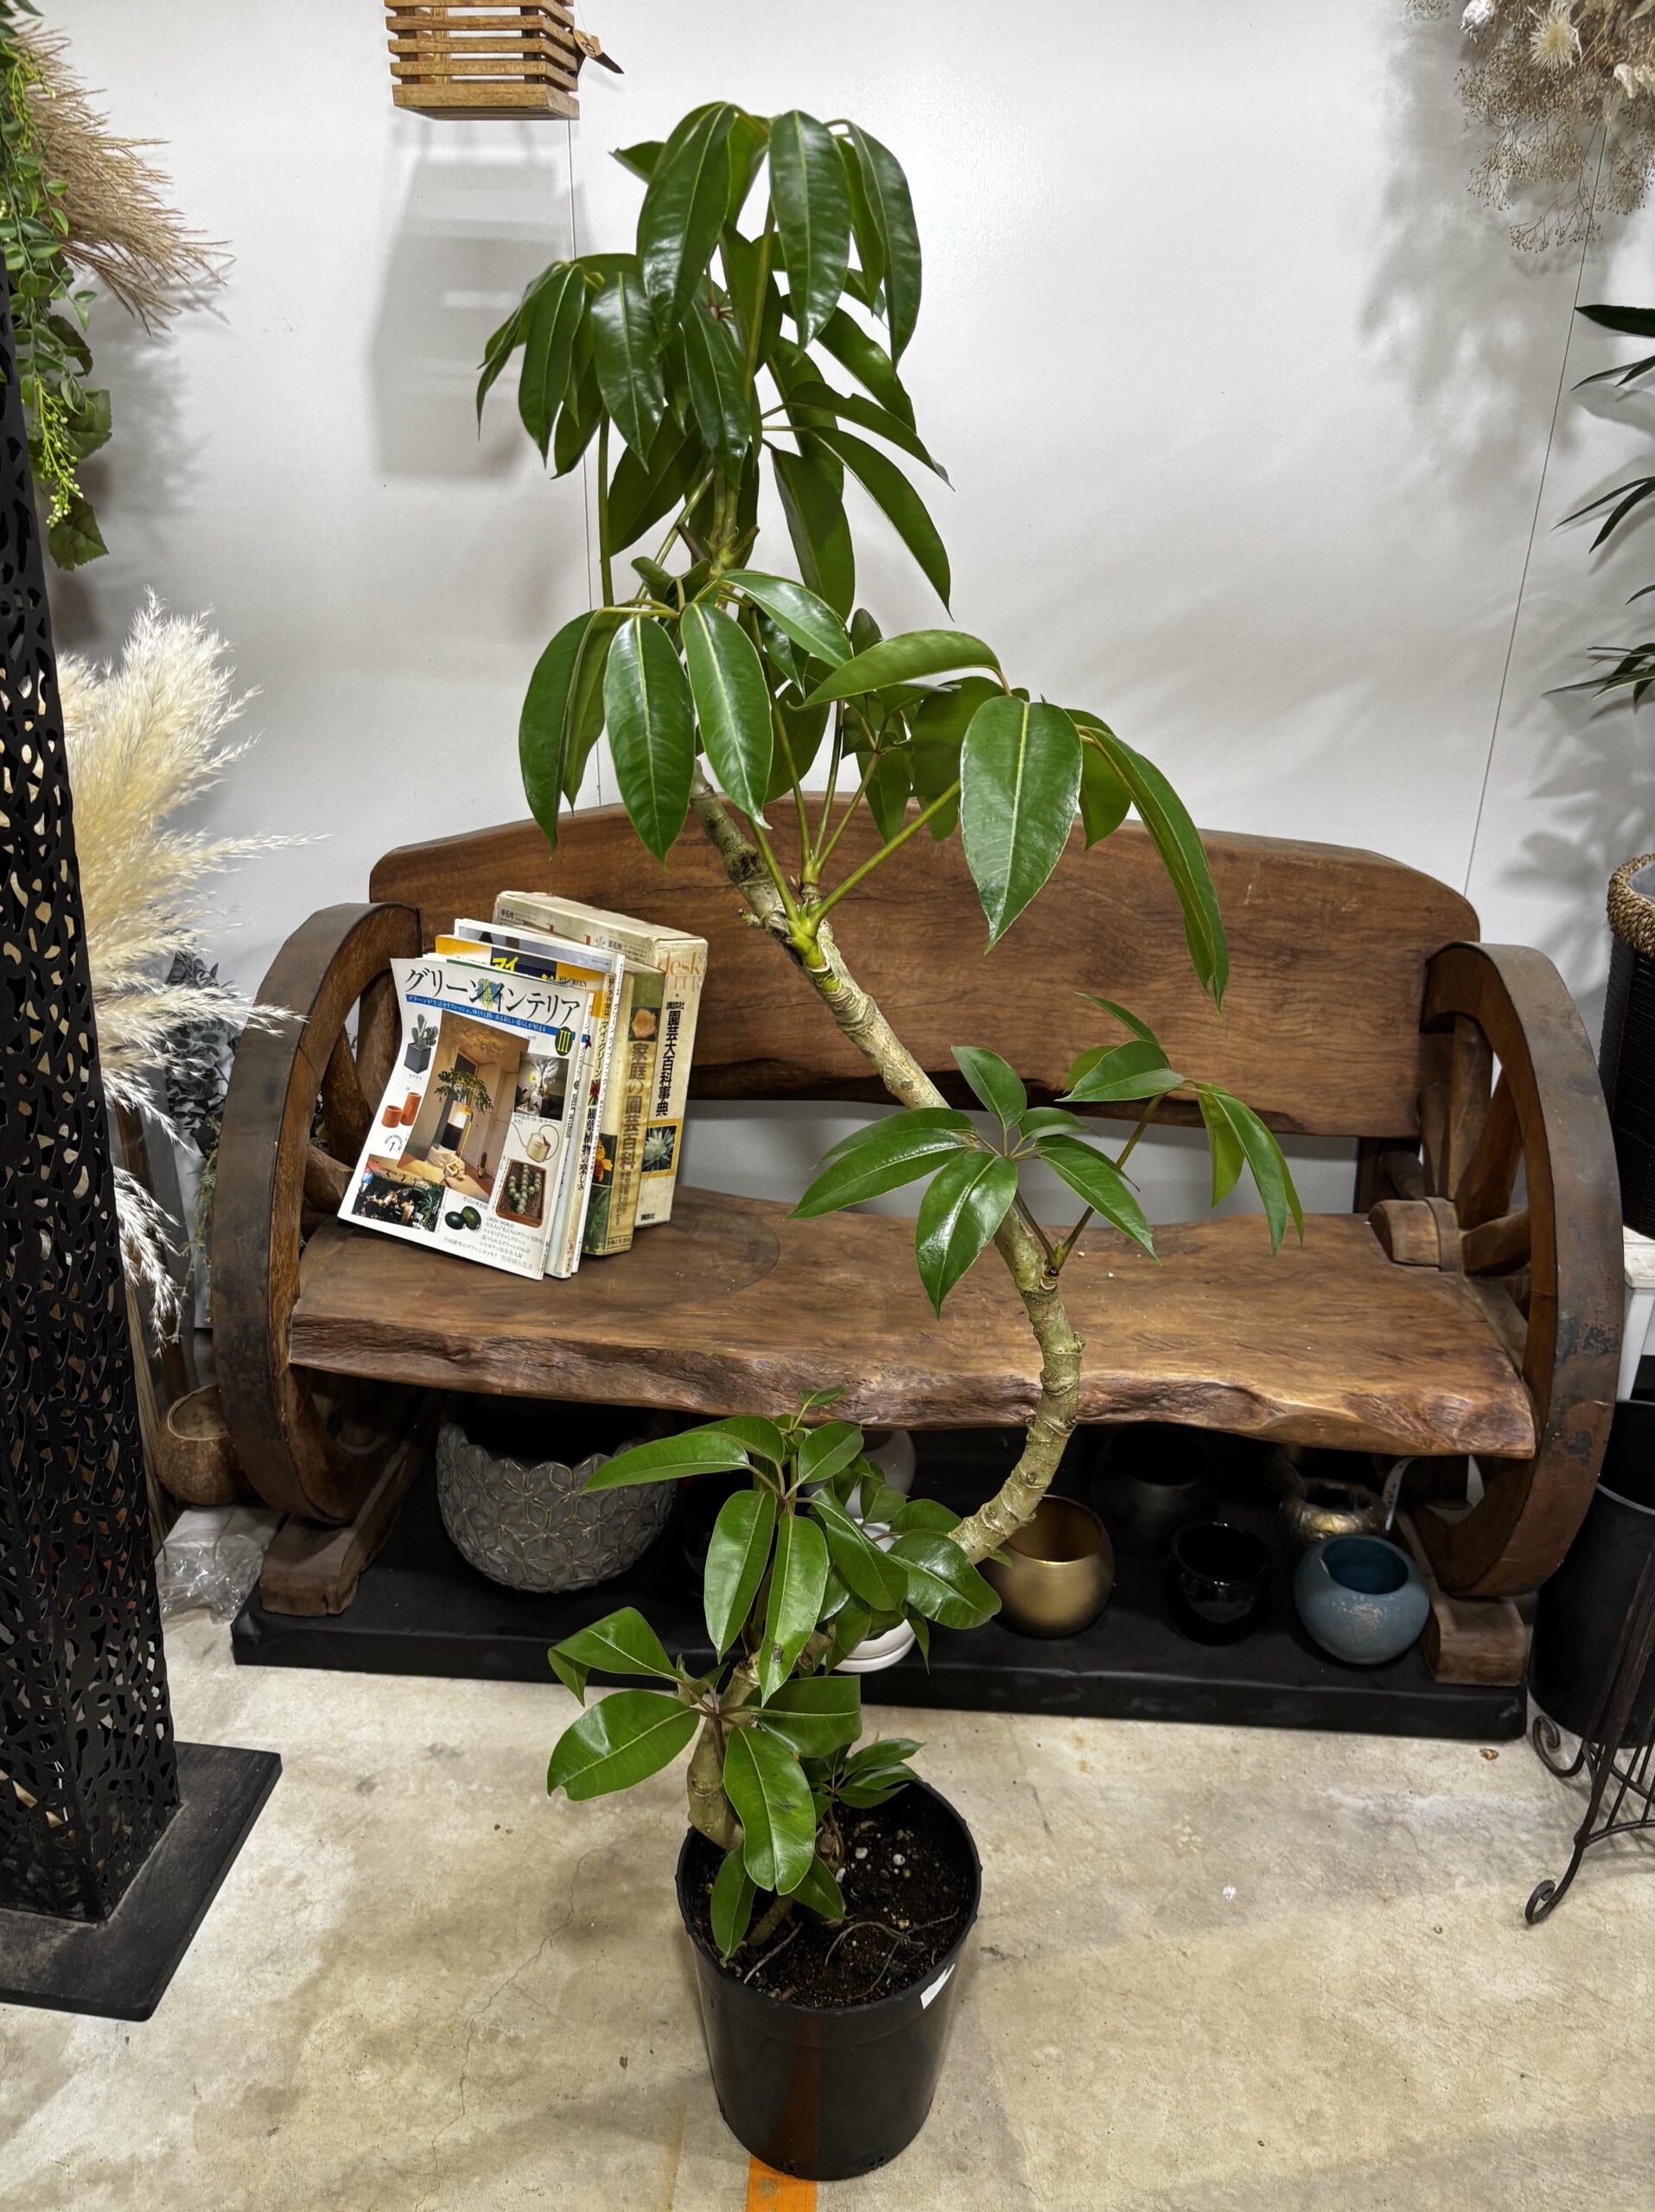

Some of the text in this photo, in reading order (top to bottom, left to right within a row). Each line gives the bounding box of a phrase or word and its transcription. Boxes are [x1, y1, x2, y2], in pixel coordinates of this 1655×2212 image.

[405, 967, 581, 1027] グリーンインテリア
[619, 1041, 650, 1170] 家庭の園芸百科
[655, 1010, 681, 1117] 園芸大百科事典
[576, 1108, 597, 1192] 観葉植物の楽しみ
